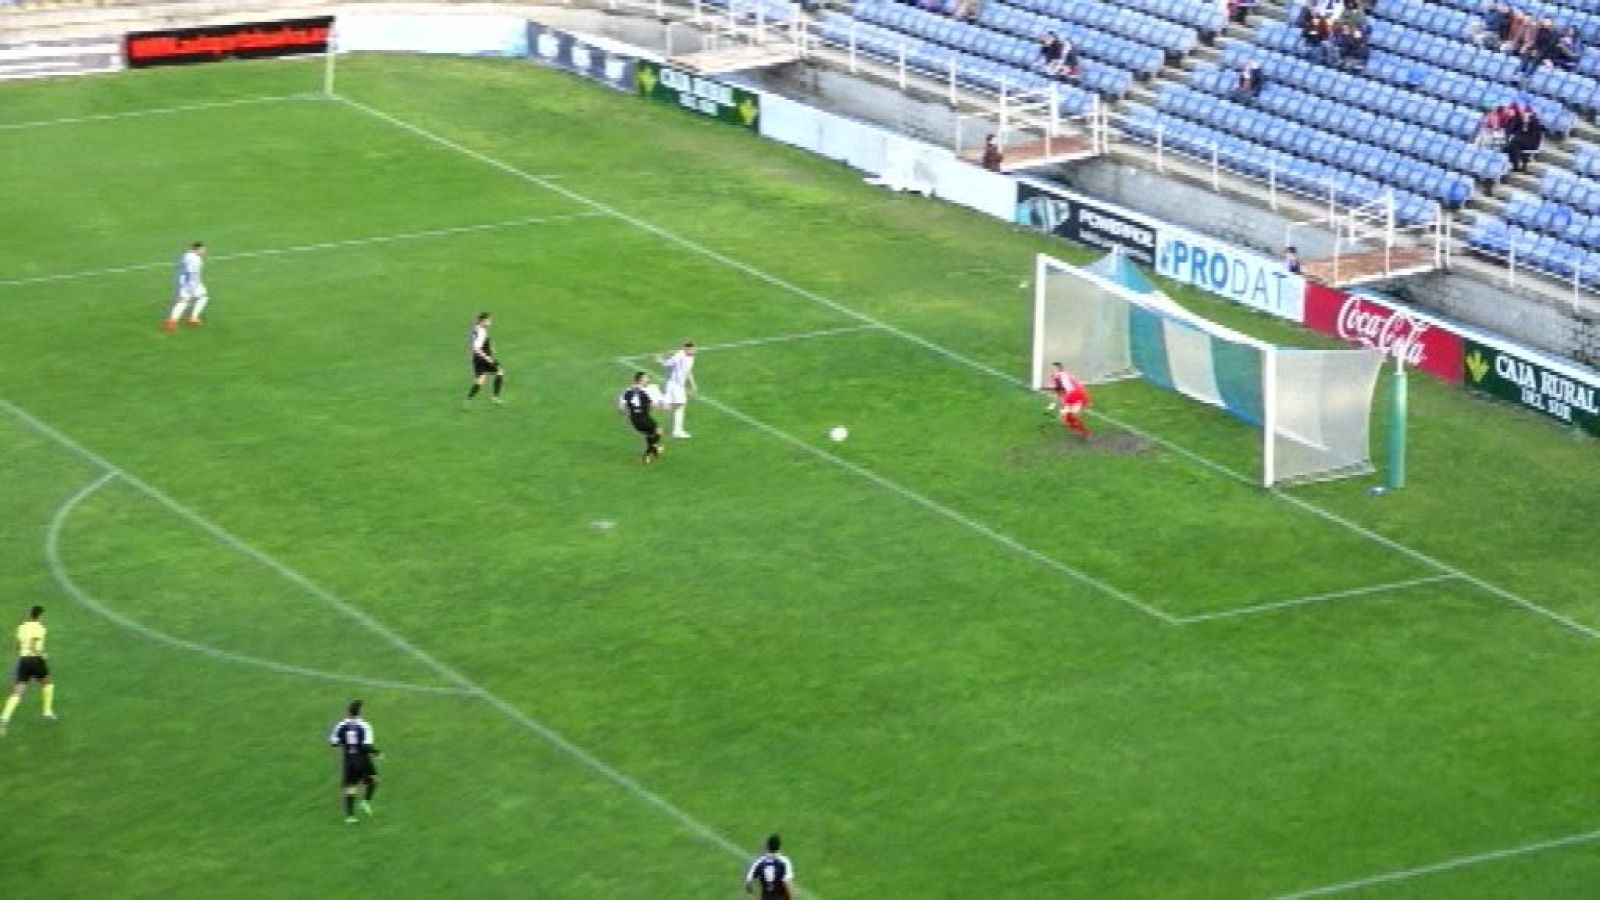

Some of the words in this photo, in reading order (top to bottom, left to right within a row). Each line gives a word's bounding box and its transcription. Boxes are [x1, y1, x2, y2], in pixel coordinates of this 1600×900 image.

[1173, 240, 1288, 309] PRODAT
[1494, 355, 1536, 388] CAJA
[1541, 371, 1599, 415] RURAL
